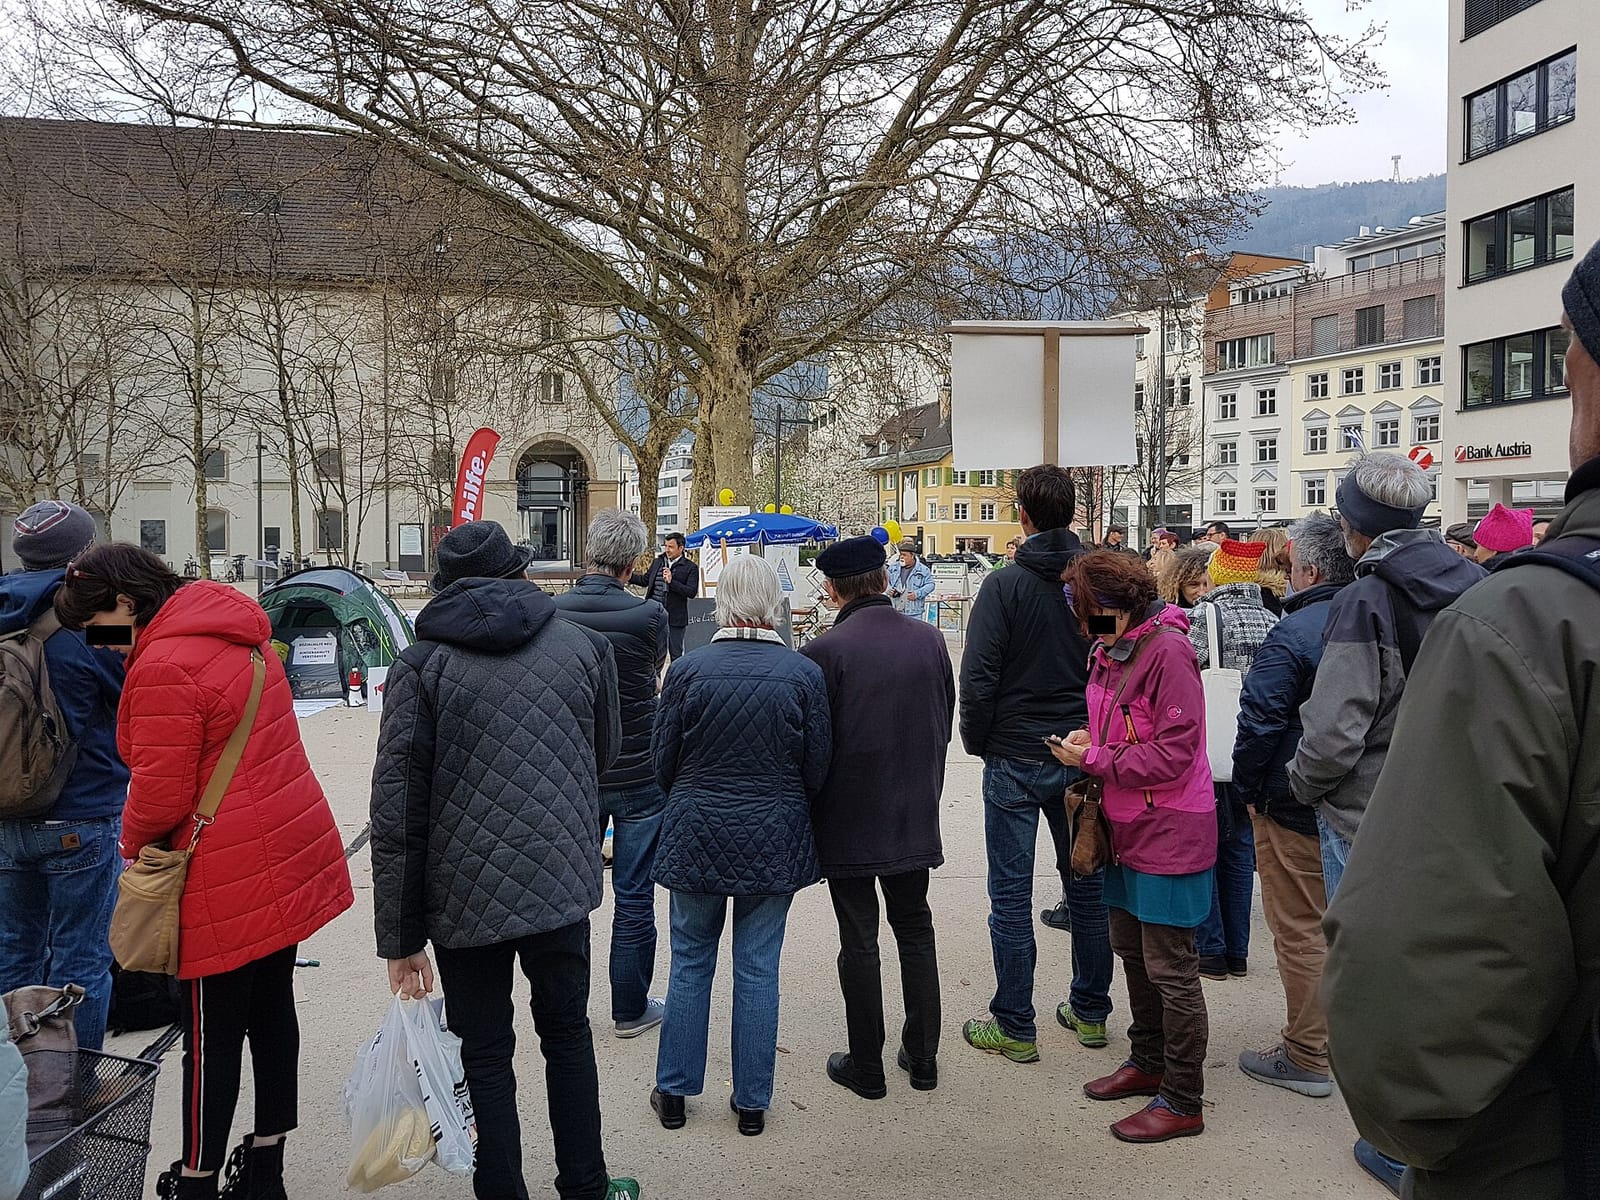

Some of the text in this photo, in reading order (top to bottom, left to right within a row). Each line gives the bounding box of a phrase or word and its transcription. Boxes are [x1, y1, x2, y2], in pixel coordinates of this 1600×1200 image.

[1467, 441, 1531, 459] Bank Austria
[461, 450, 487, 524] hilfe.
